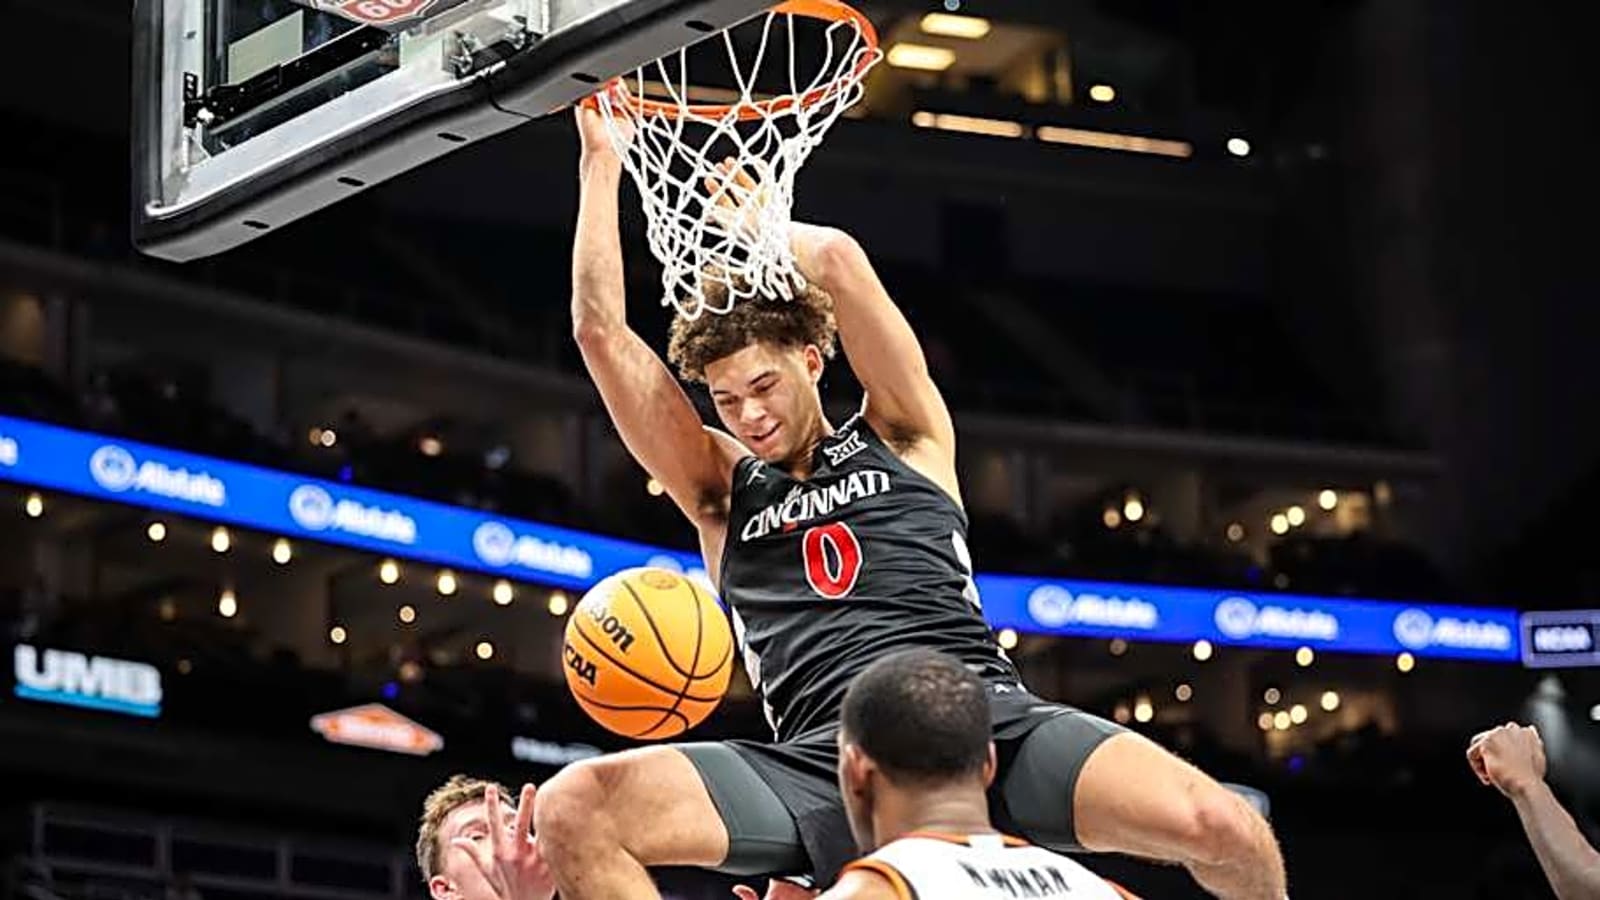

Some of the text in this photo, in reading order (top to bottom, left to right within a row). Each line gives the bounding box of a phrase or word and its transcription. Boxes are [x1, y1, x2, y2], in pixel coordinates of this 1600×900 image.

[741, 470, 891, 541] CINCINNATI
[803, 521, 862, 599] 0
[14, 643, 163, 704] UMB
